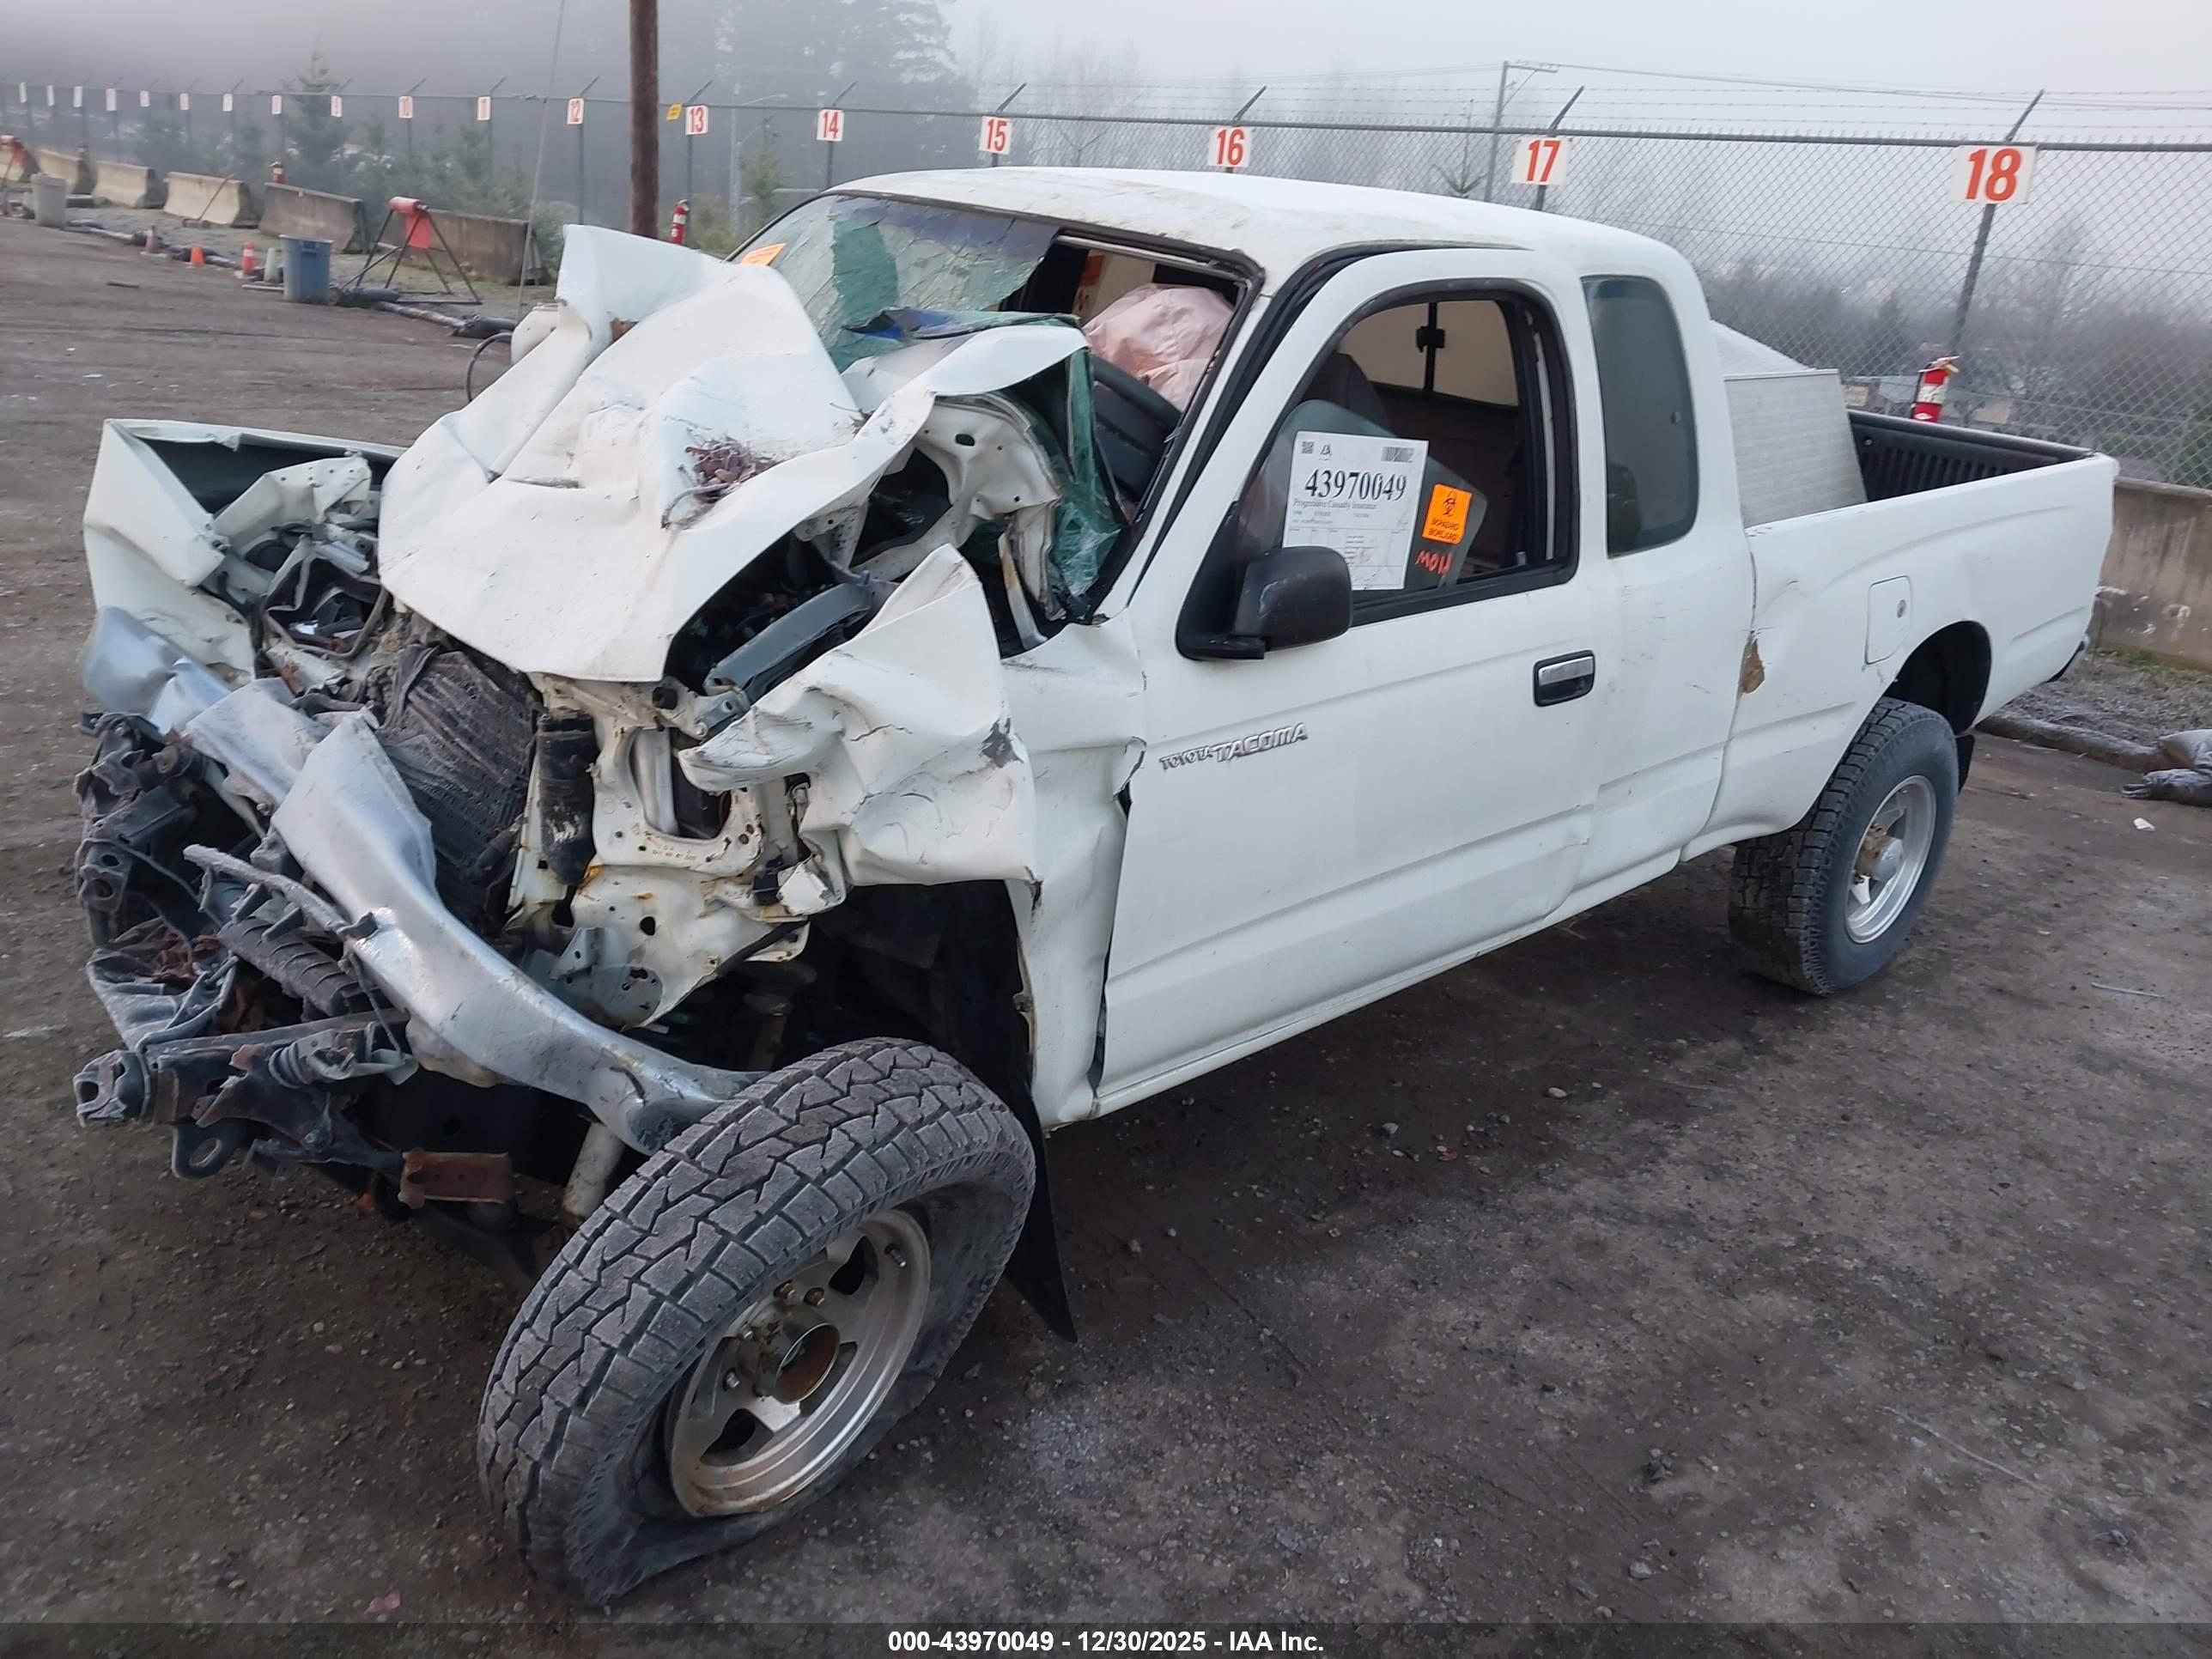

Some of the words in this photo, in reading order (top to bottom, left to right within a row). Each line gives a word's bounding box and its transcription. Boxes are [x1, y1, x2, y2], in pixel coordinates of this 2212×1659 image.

[569, 100, 581, 123] 12
[689, 106, 705, 133] 13
[823, 112, 839, 139] 14
[987, 119, 1006, 152] 15
[1216, 128, 1245, 166] 16
[1526, 139, 1560, 182] 17
[1966, 148, 2021, 202] 18
[1304, 469, 1407, 501] 43970049
[1159, 745, 1212, 770] TOYOTA
[1211, 722, 1309, 763] TACOMA
